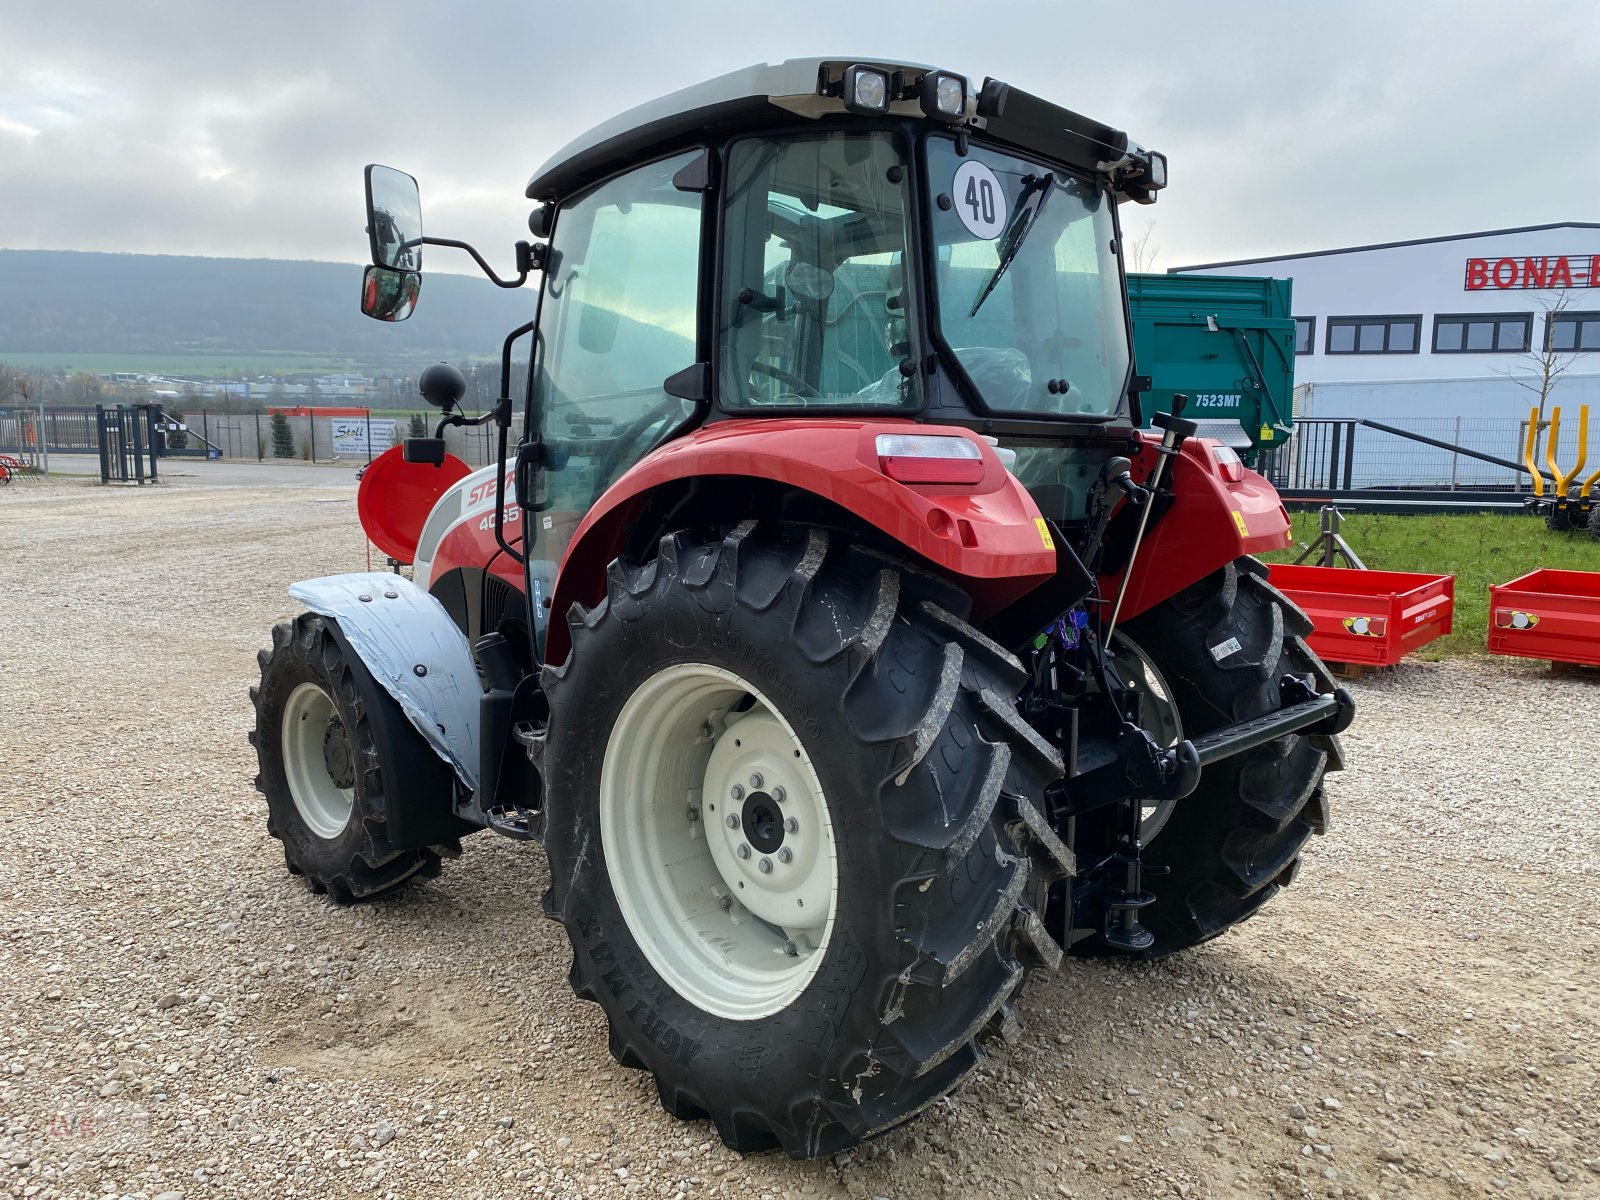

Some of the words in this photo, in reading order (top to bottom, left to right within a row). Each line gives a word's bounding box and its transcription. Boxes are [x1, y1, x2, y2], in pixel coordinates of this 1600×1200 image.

[965, 175, 996, 225] 40
[1195, 394, 1242, 407] 7523MT
[334, 425, 364, 439] Stoll
[467, 470, 516, 508] STER
